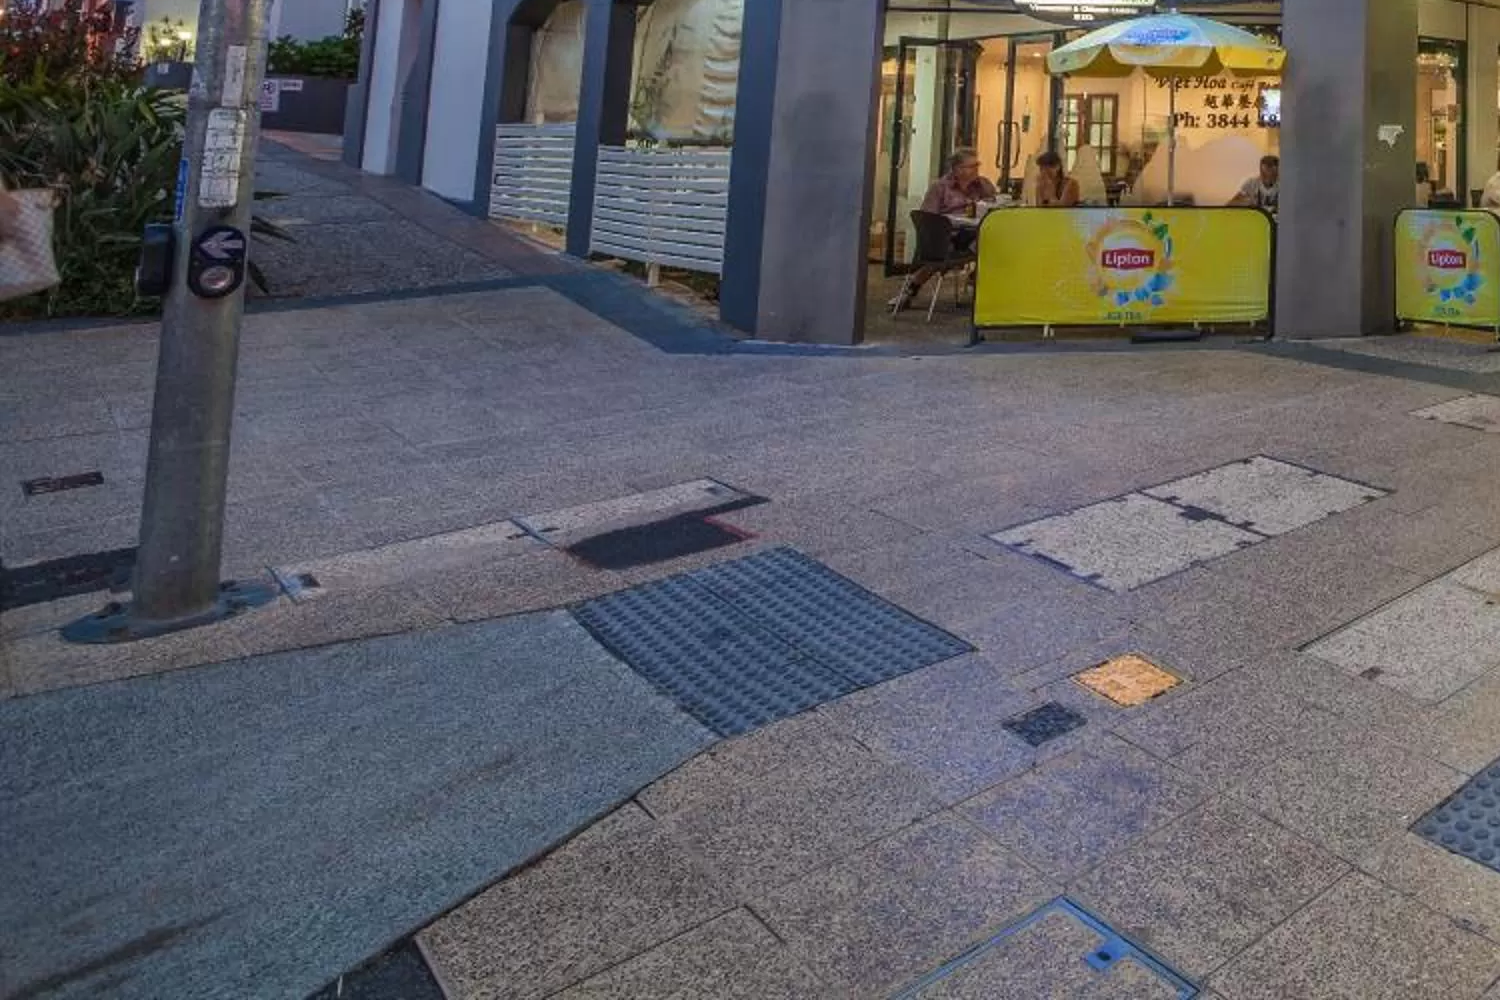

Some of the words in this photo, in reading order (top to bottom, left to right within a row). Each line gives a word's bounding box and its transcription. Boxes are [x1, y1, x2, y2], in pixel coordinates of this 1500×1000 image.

[1174, 111, 1200, 128] Ph:
[1207, 113, 1251, 128] 3844
[1105, 253, 1150, 267] Lipton
